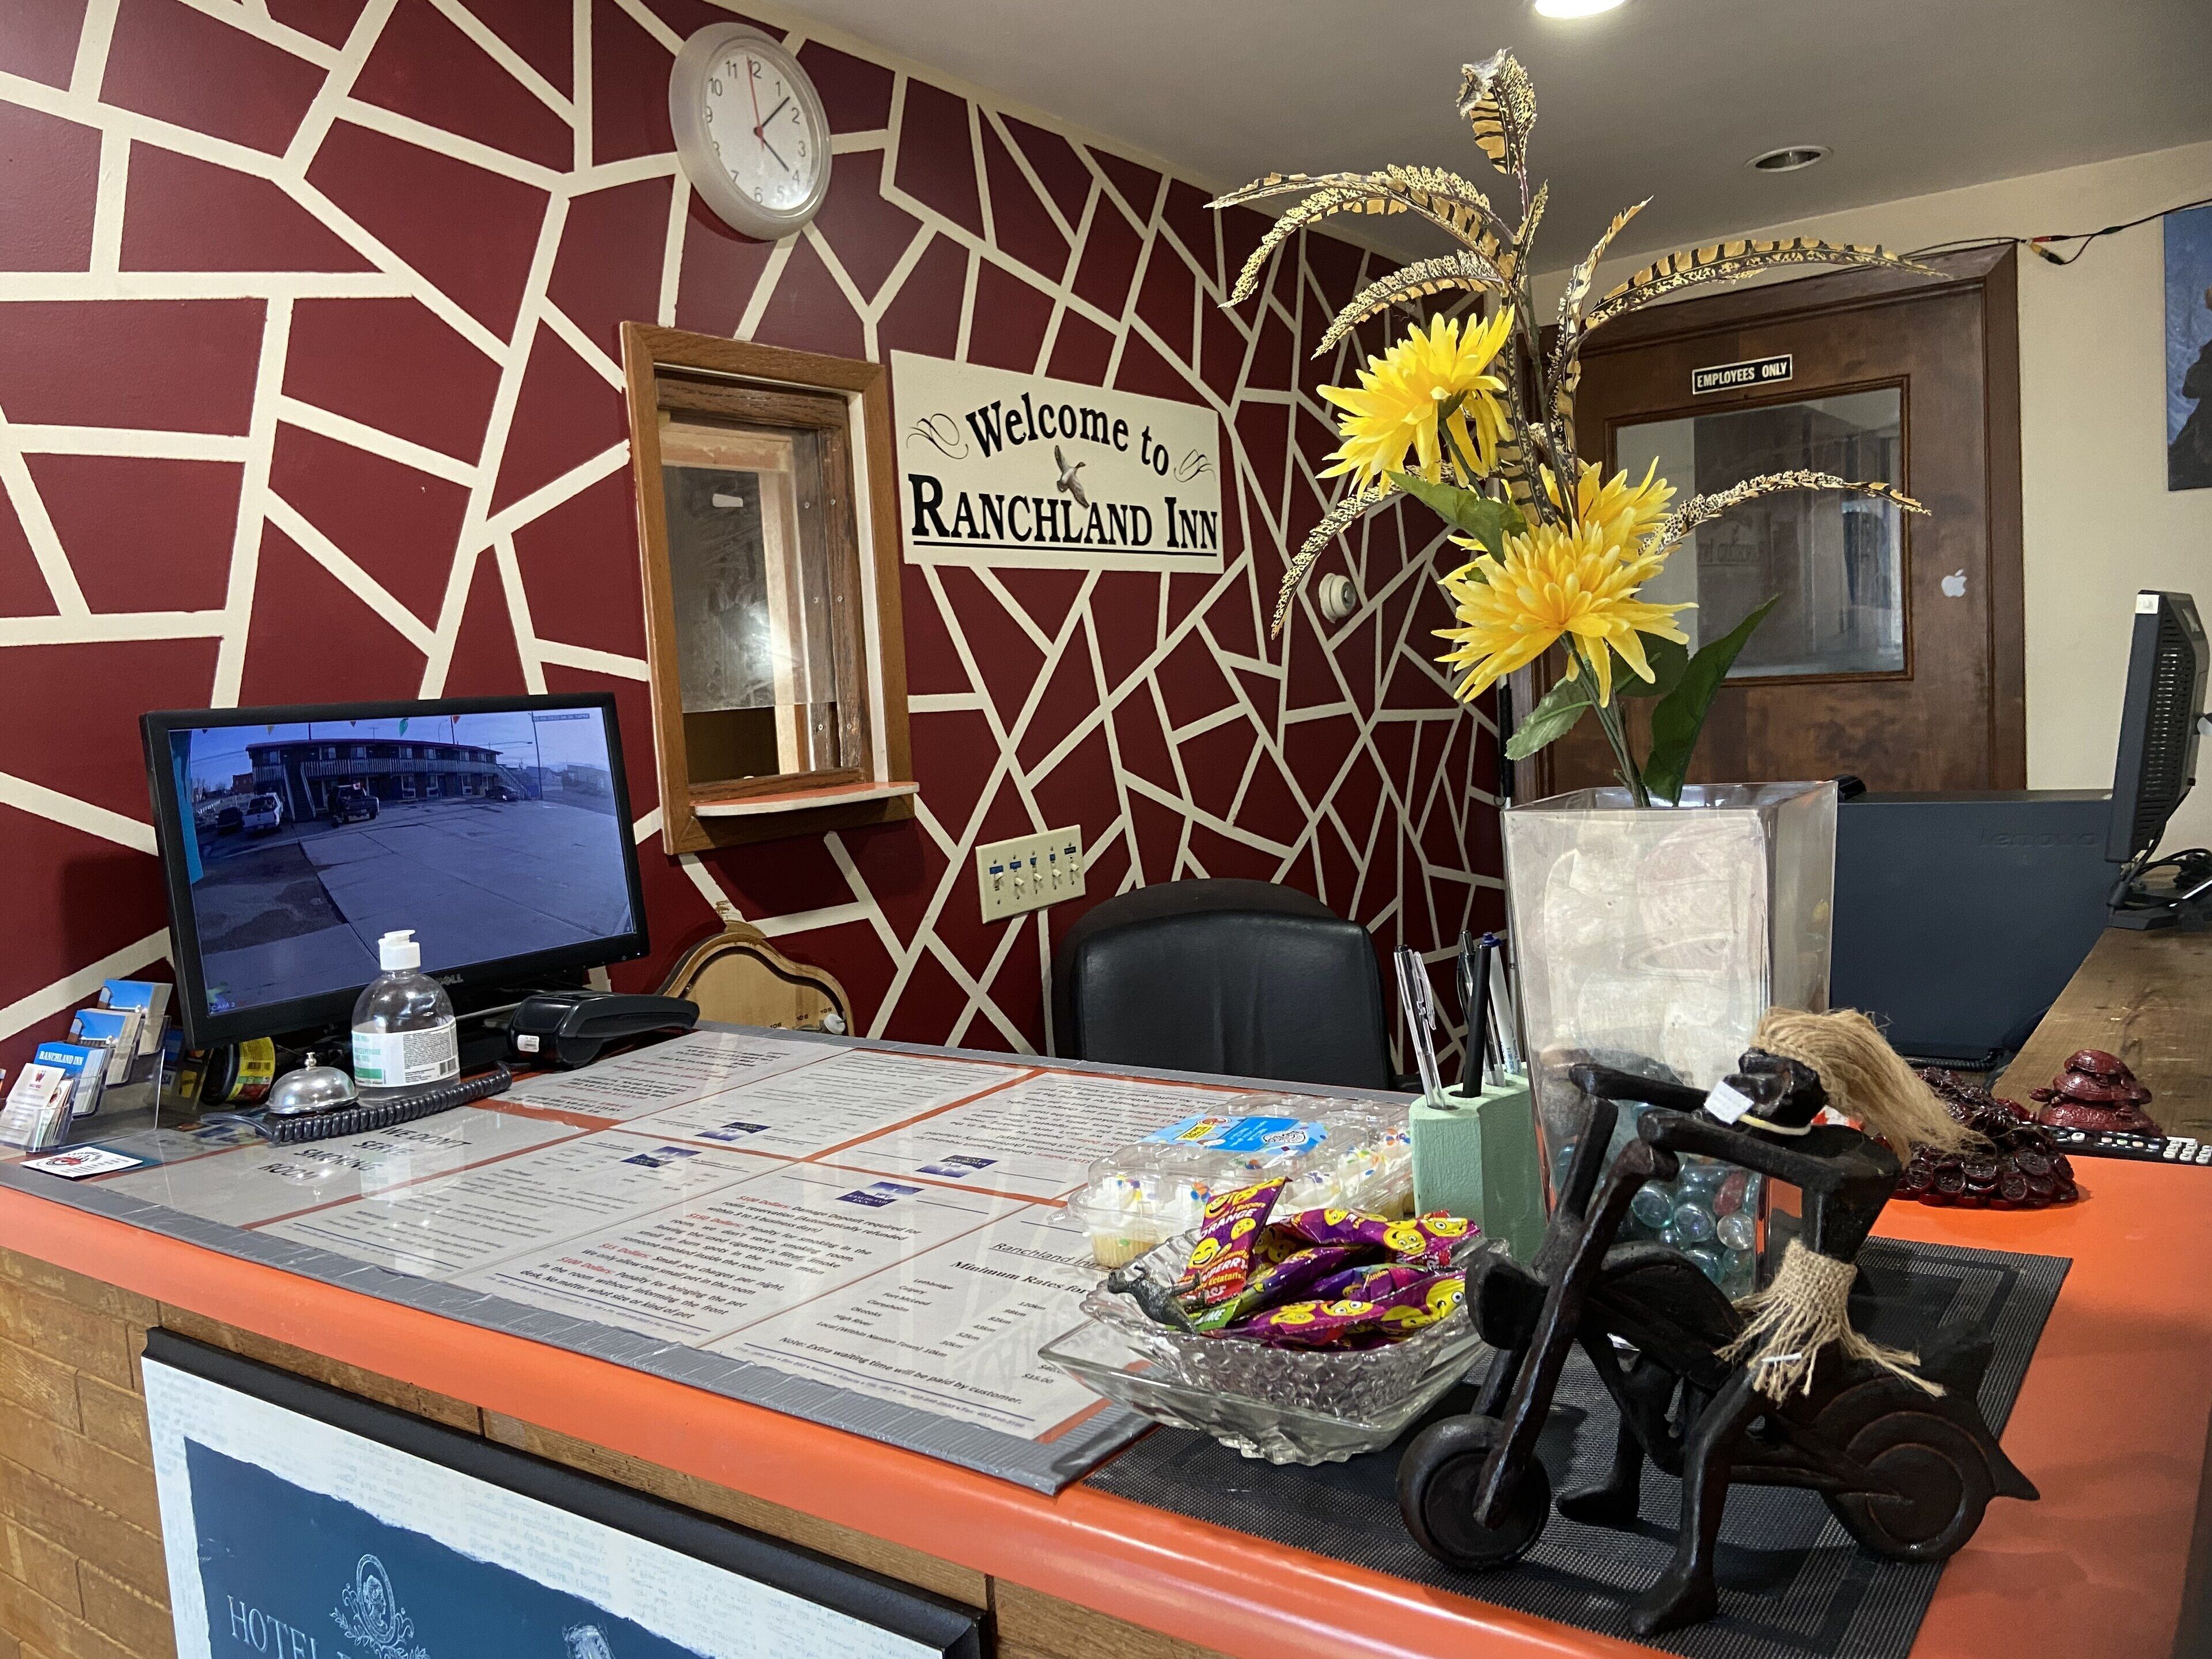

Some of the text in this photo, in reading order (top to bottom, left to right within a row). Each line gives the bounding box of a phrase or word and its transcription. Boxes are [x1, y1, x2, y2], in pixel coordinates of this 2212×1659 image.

[725, 60, 738, 79] 11
[748, 60, 762, 78] 12
[710, 77, 724, 96] 10
[775, 81, 781, 97] 1
[705, 105, 713, 123] 9
[791, 108, 800, 124] 2
[798, 141, 806, 157] 3
[792, 171, 800, 185] 4
[754, 187, 763, 203] 6
[777, 185, 785, 201] 5
[1697, 362, 1787, 388] EMPLOYEES ONLY
[966, 392, 1169, 476] Welcome to
[908, 474, 1217, 550] RANCHLAND INN
[39, 1051, 84, 1066] RANCHLAND INN
[353, 1141, 415, 1156] SERVE
[379, 1126, 472, 1149] WE DON'T
[257, 1162, 319, 1180] ROOM
[293, 1149, 384, 1171] SMOKING
[706, 1207, 734, 1215] within
[759, 1217, 797, 1228] business
[796, 1225, 823, 1233] days)
[746, 1206, 795, 1218] reservation
[794, 1215, 862, 1232] (Automatically
[862, 1229, 908, 1241] refunded
[791, 1206, 828, 1216] Damage
[828, 1214, 864, 1224] Deposit
[864, 1221, 906, 1232] required
[654, 1224, 687, 1234] leaving
[807, 1257, 841, 1268] smoke
[746, 1225, 780, 1235] Penalty
[797, 1236, 839, 1249] smoking
[781, 1243, 821, 1254] smoking
[620, 1236, 661, 1248] someone
[659, 1245, 698, 1255] smoked
[738, 1263, 765, 1272] room
[702, 1245, 729, 1253] spots
[764, 1259, 793, 1267] room
[795, 1267, 825, 1275] mean
[993, 1243, 1101, 1269] Ranchland Inn
[556, 1257, 583, 1265] $100
[615, 1272, 652, 1283] Penalty
[666, 1285, 709, 1298] bringing
[652, 1256, 681, 1265] Small
[698, 1267, 736, 1278] charges
[950, 1261, 1090, 1294] Minimum Rates for
[556, 1280, 589, 1290] matter
[588, 1288, 614, 1297] what
[641, 1301, 667, 1310] kind
[567, 1271, 594, 1280] room
[595, 1278, 634, 1290] without
[632, 1287, 681, 1303] informing
[700, 1305, 729, 1315] front
[728, 1286, 756, 1295] room
[899, 1285, 1027, 1317] Calgary 98km
[899, 1296, 932, 1306] McLeod
[913, 1278, 1046, 1310] Lethbridge 120km
[867, 1300, 909, 1312] Claresholm
[850, 1306, 980, 1341] Okotoks 52km
[851, 1318, 874, 1326] River
[940, 1340, 964, 1349] 30km
[816, 1321, 948, 1357] Local (Within Nanton Town) 10km
[779, 1337, 807, 1347] Note:
[806, 1344, 832, 1353] Extra
[834, 1350, 869, 1363] waiting
[869, 1360, 893, 1370] time
[926, 1377, 956, 1385] paid
[969, 1386, 1022, 1404] customer.
[1021, 1373, 1054, 1384] $15.00
